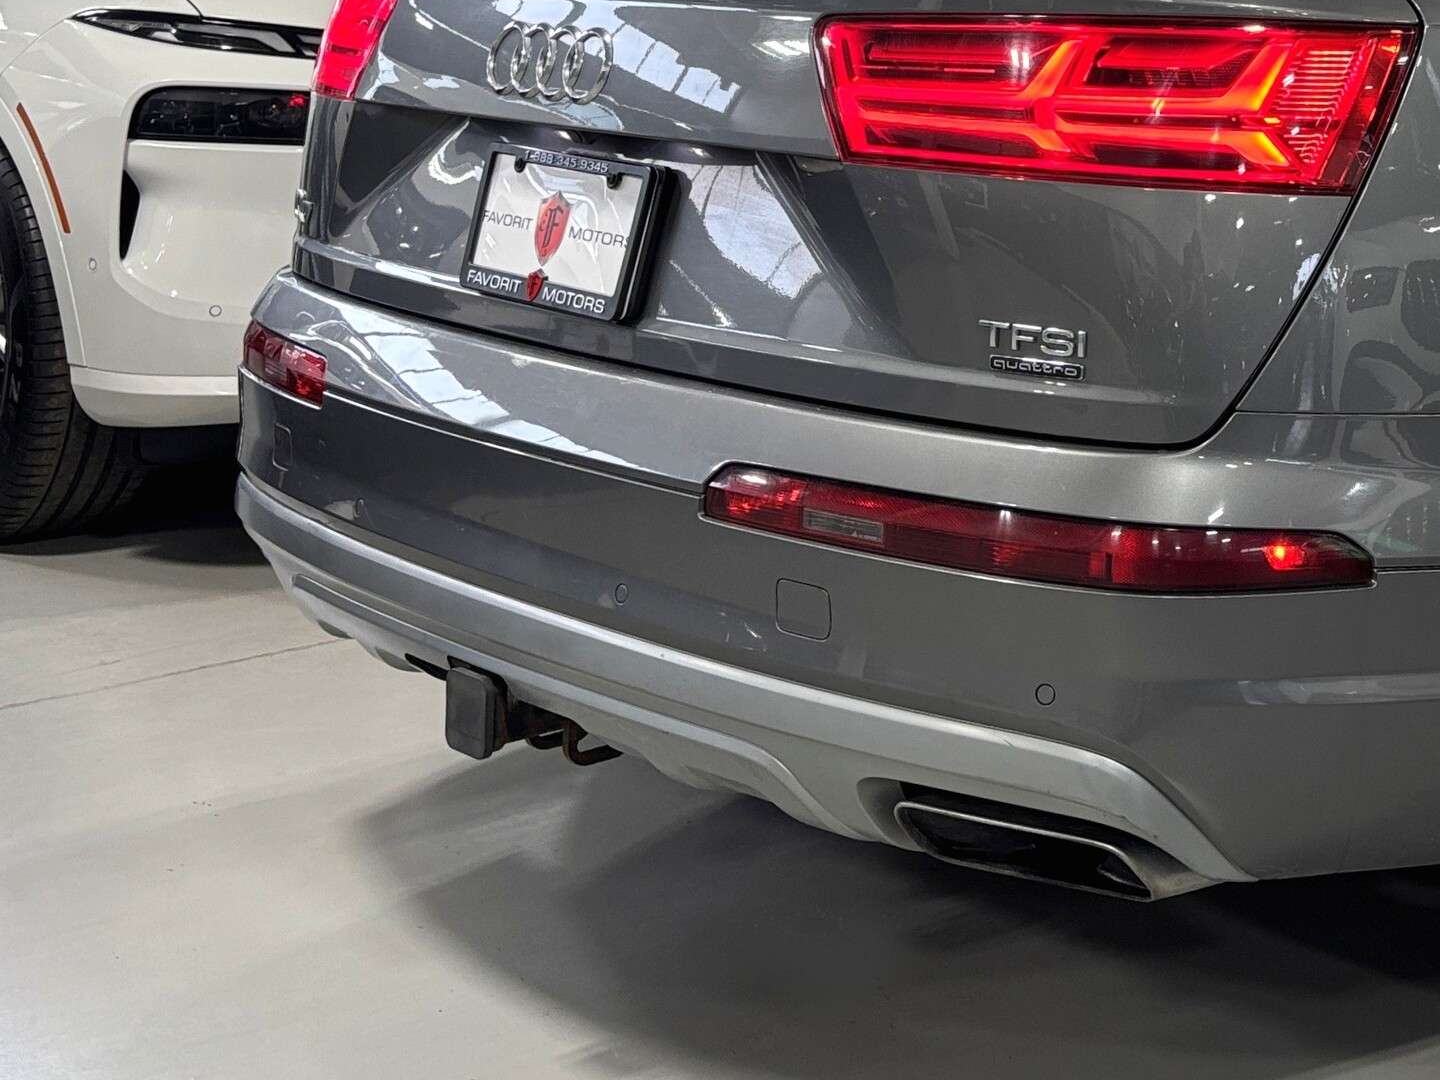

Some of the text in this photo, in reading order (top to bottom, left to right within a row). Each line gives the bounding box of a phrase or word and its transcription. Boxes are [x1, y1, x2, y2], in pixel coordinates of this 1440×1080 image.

[483, 209, 533, 231] FAVORIT
[466, 270, 605, 314] FAVORIT MOTORS
[978, 319, 1087, 358] TFSI
[993, 359, 1078, 377] quattro
